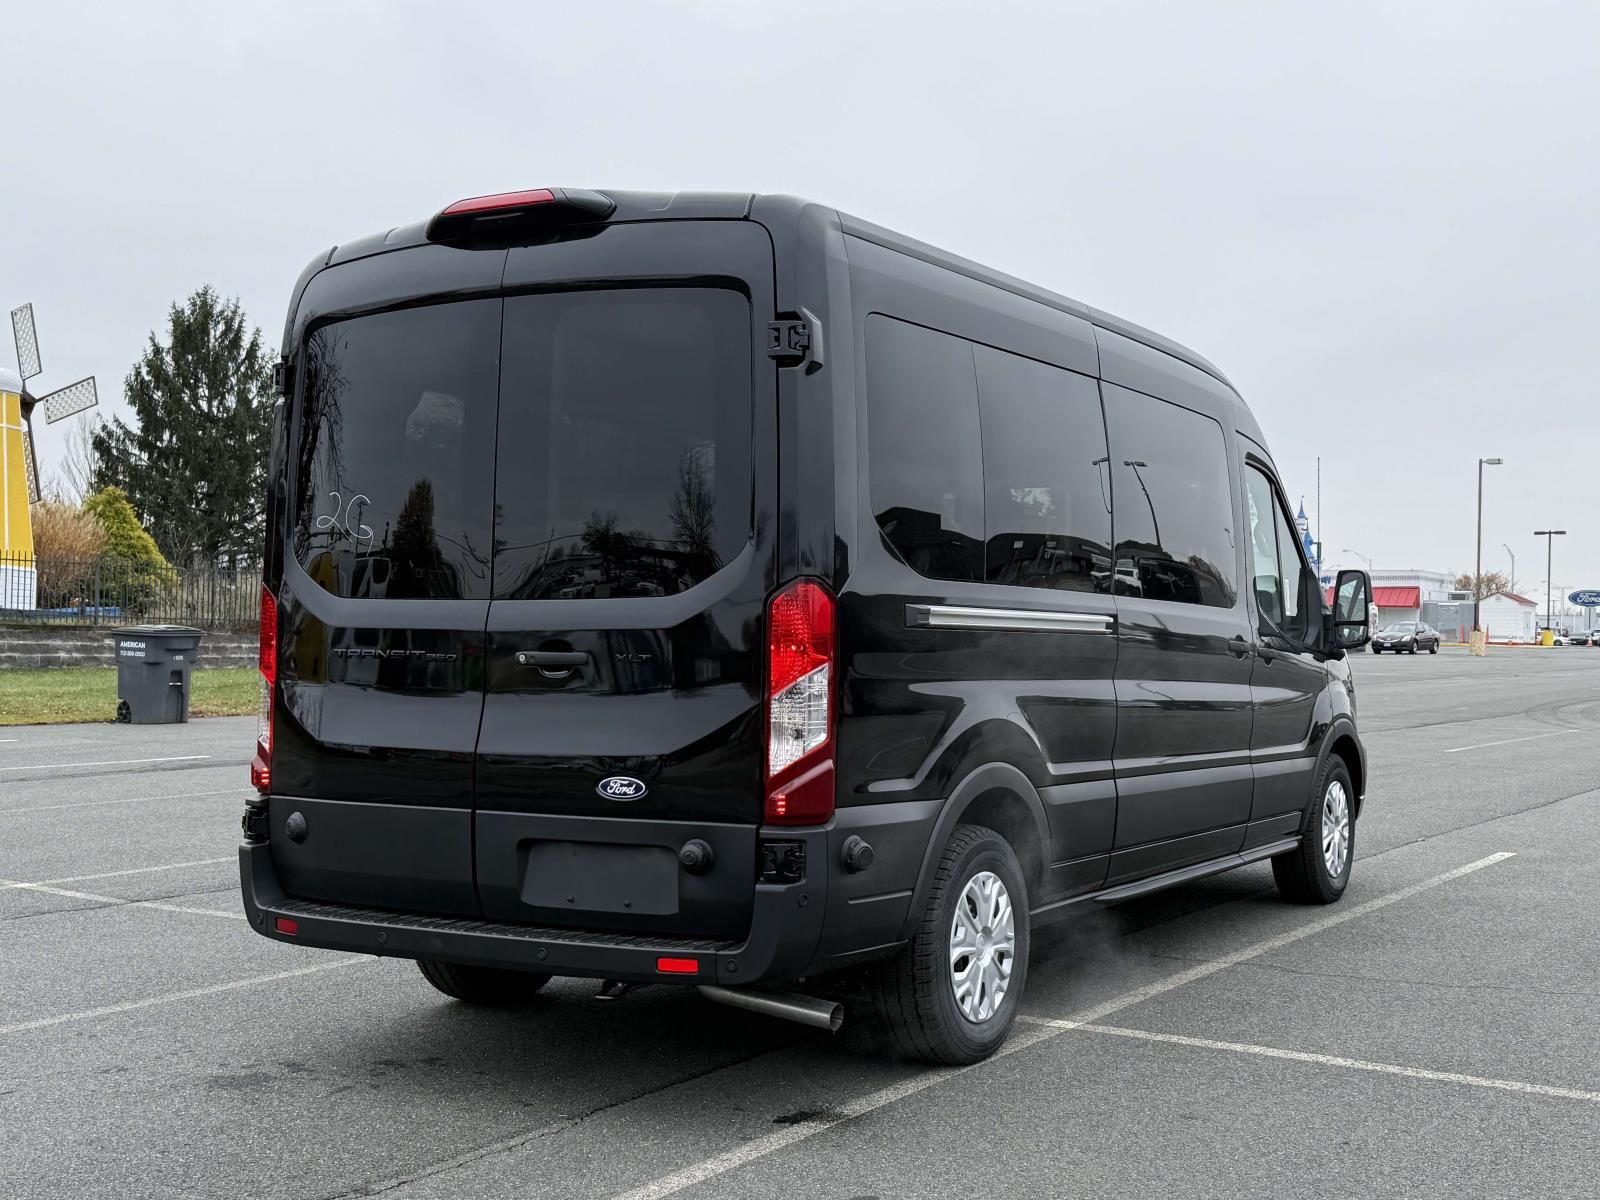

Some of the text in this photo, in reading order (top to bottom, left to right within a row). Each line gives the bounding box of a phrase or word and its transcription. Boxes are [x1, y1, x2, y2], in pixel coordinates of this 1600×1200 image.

[120, 641, 146, 649] AMERICAN
[333, 648, 426, 659] TRANSIT
[616, 653, 652, 662] XLT
[607, 779, 636, 794] Ford
